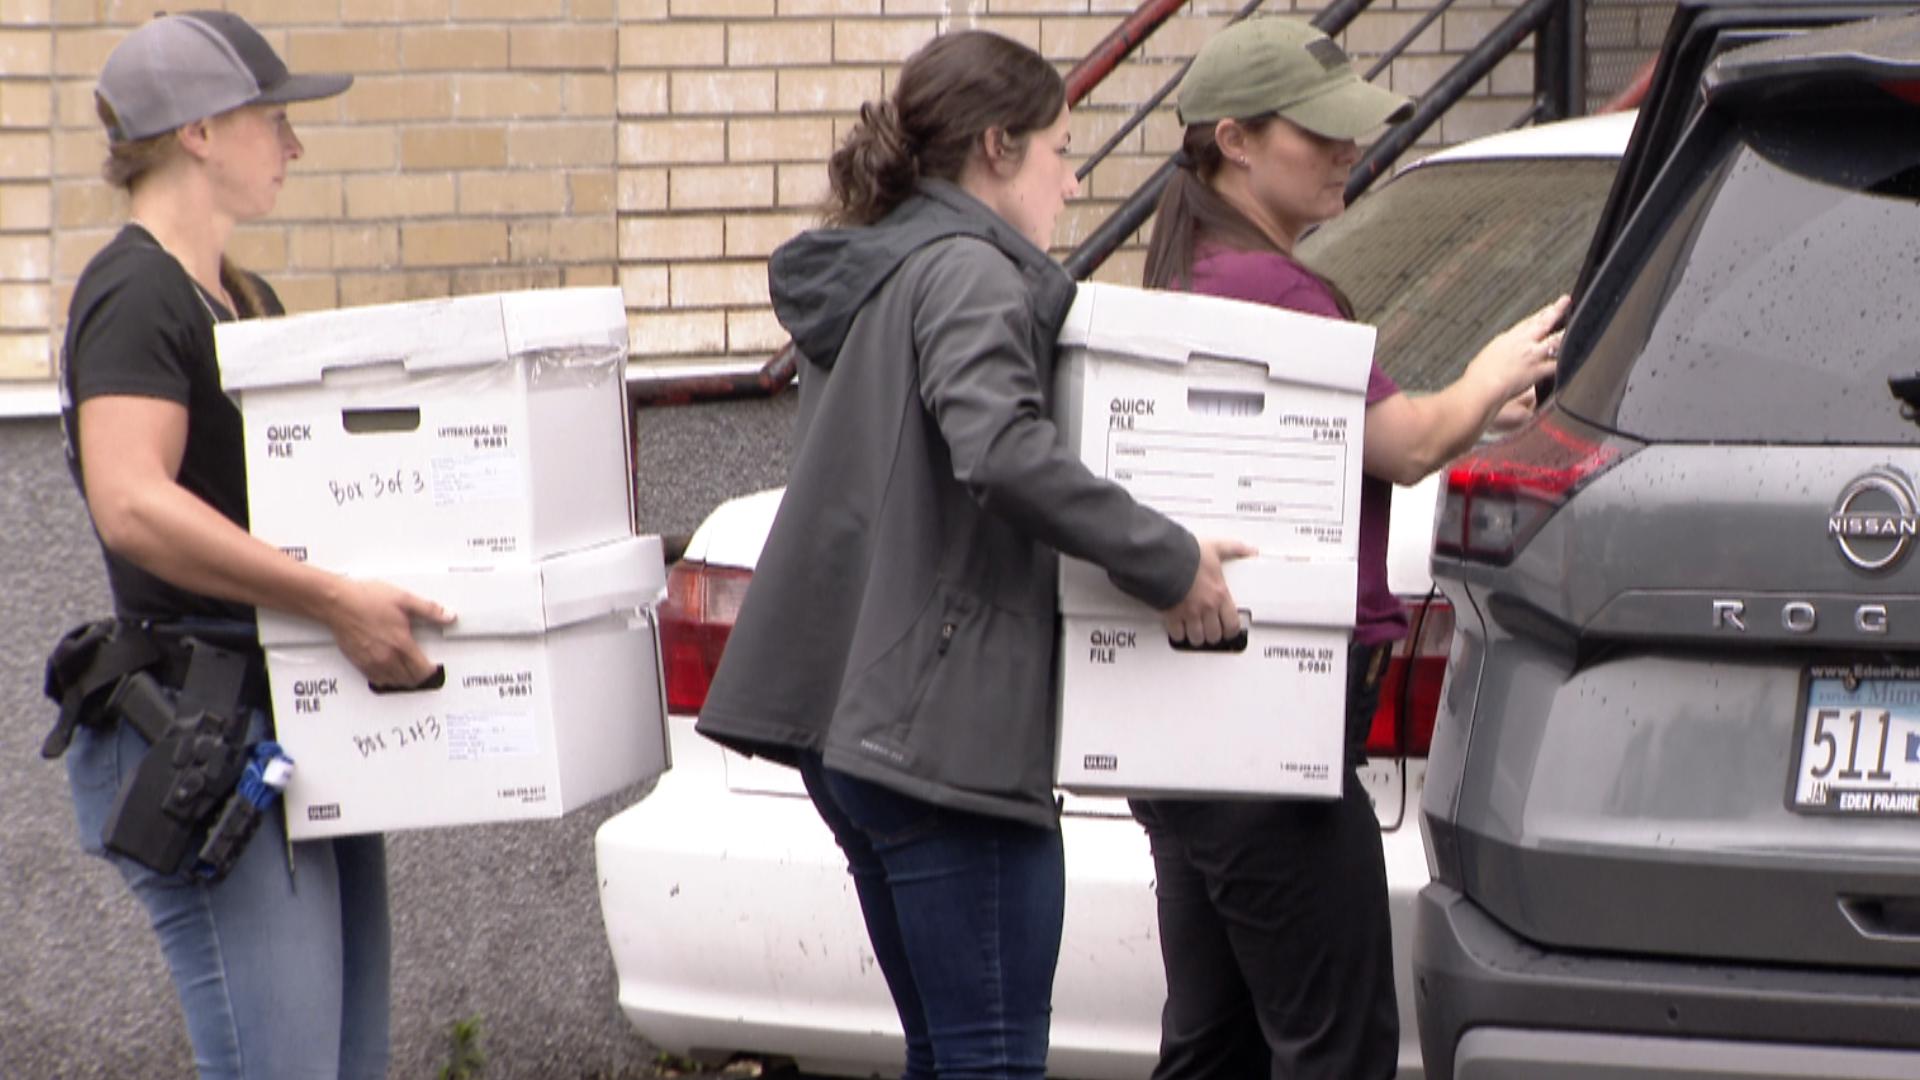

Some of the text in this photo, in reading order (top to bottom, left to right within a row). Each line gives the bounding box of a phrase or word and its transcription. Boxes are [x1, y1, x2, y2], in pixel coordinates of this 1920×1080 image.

[1109, 397, 1156, 416] QUICK
[1109, 415, 1135, 431] FILE
[1332, 417, 1347, 429] SIZE
[266, 424, 312, 441] QUICK
[267, 442, 293, 457] FILE
[328, 479, 363, 506] Box
[369, 472, 384, 498] 3
[388, 469, 402, 495] of
[412, 469, 425, 494] 3
[1828, 517, 1916, 534] NISSAN
[1712, 600, 1888, 633] ROG
[1090, 629, 1137, 649] QUICK
[1090, 647, 1116, 664] FILE
[1318, 648, 1334, 660] SIZE
[293, 678, 339, 697] QUICK
[295, 698, 321, 714] FILE
[391, 726, 409, 747] 2
[425, 714, 441, 741] 3
[1810, 709, 1891, 780] 511
[1084, 754, 1117, 770] ULINE
[1806, 781, 1831, 804] JAN
[1840, 791, 1919, 813] EDEN PRAIRIE
